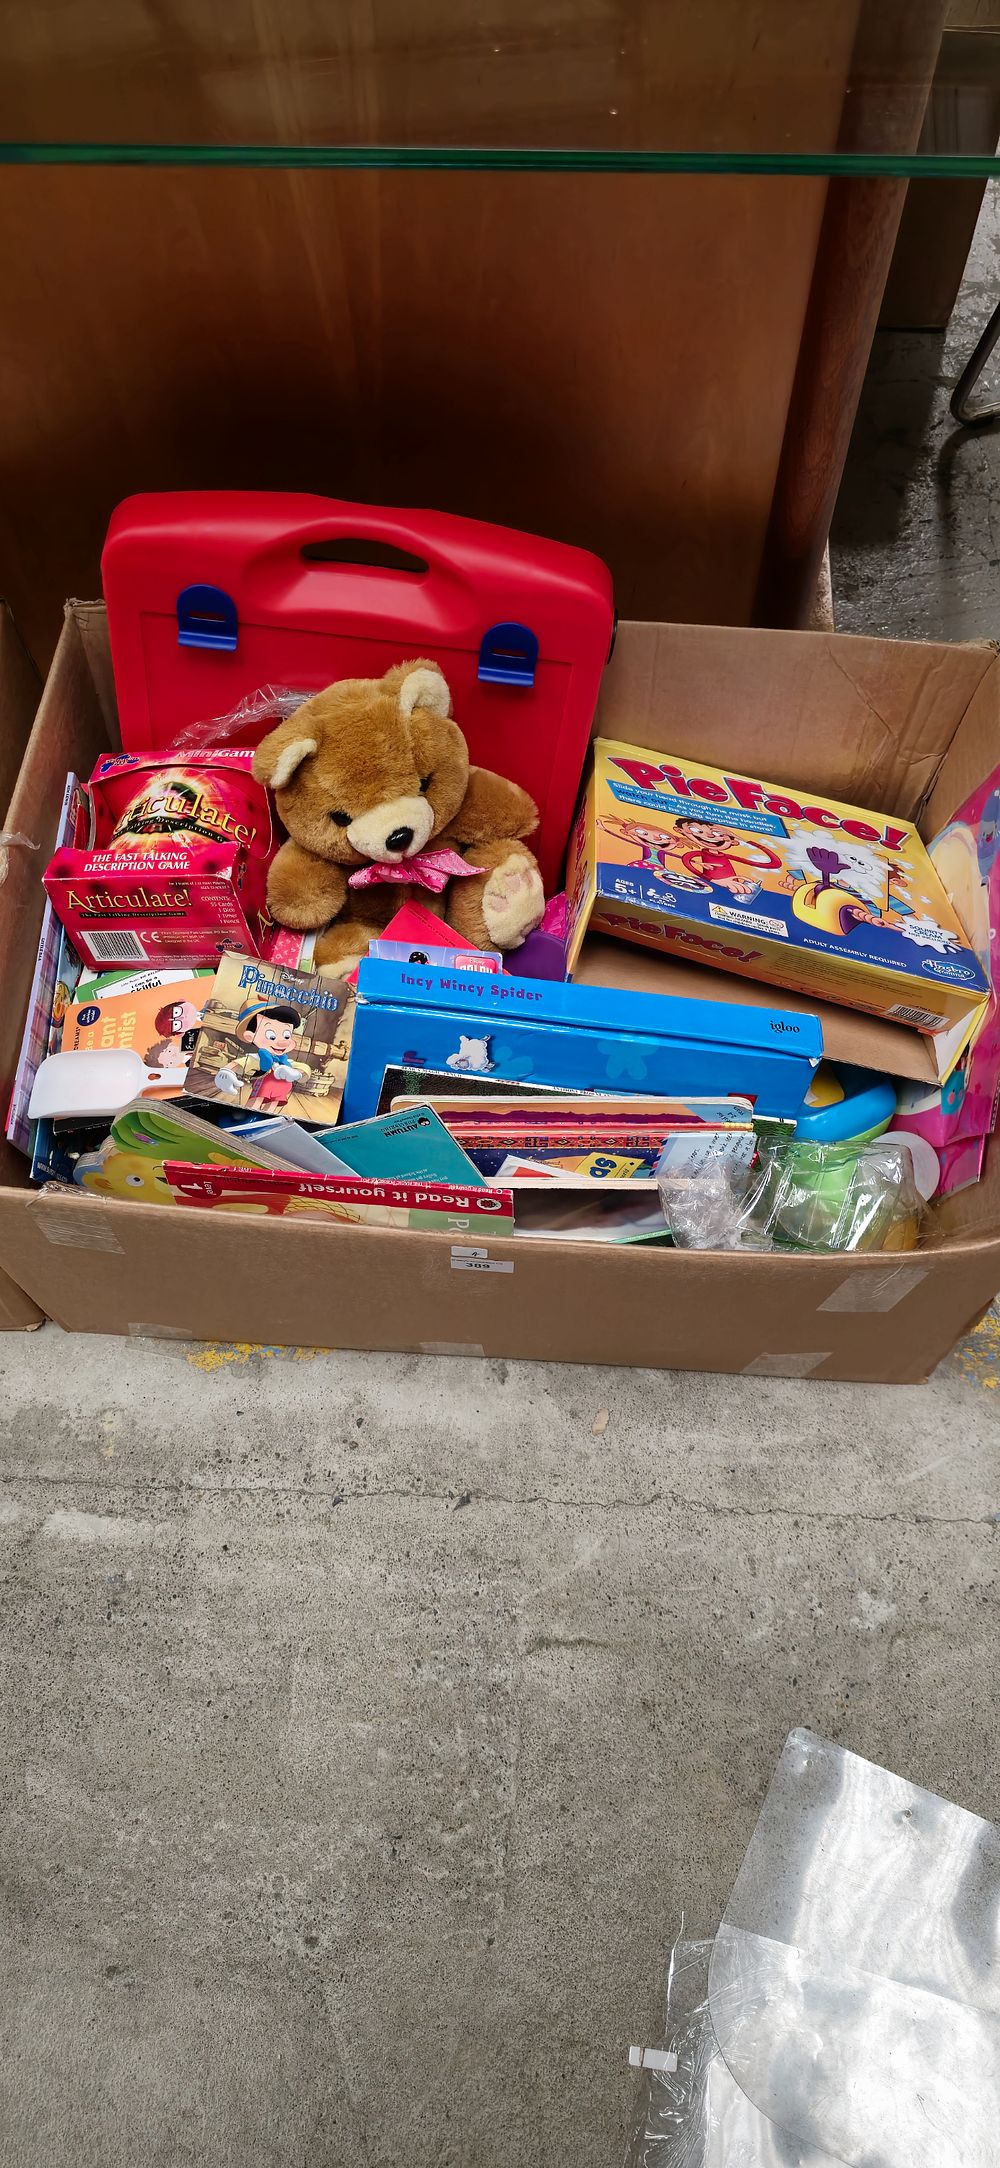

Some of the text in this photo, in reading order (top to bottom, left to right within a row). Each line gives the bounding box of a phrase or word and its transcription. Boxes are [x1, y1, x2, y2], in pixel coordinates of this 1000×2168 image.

[177, 749, 256, 758] MiniGam
[607, 756, 909, 852] Pie Face!
[114, 794, 257, 849] rticulate!
[84, 861, 191, 872] DESCRIPTION GAME
[92, 851, 187, 863] THE FAST TALKING
[615, 878, 634, 887] AGES
[615, 882, 637, 895] 5+
[66, 887, 192, 914] Articulate!
[599, 912, 763, 963] Pie Face!
[803, 937, 907, 968] ADULT ASSEMBLY REQUIRED
[131, 980, 162, 993] kilful
[238, 965, 338, 1012] Pinocchio
[401, 973, 543, 1001] Incy Wincy Spider
[101, 1016, 116, 1048] ant
[118, 1011, 136, 1049] ntist
[770, 1020, 800, 1034] igloo
[384, 1123, 418, 1138] AUTUMN
[298, 1183, 469, 1208] Read it yourself
